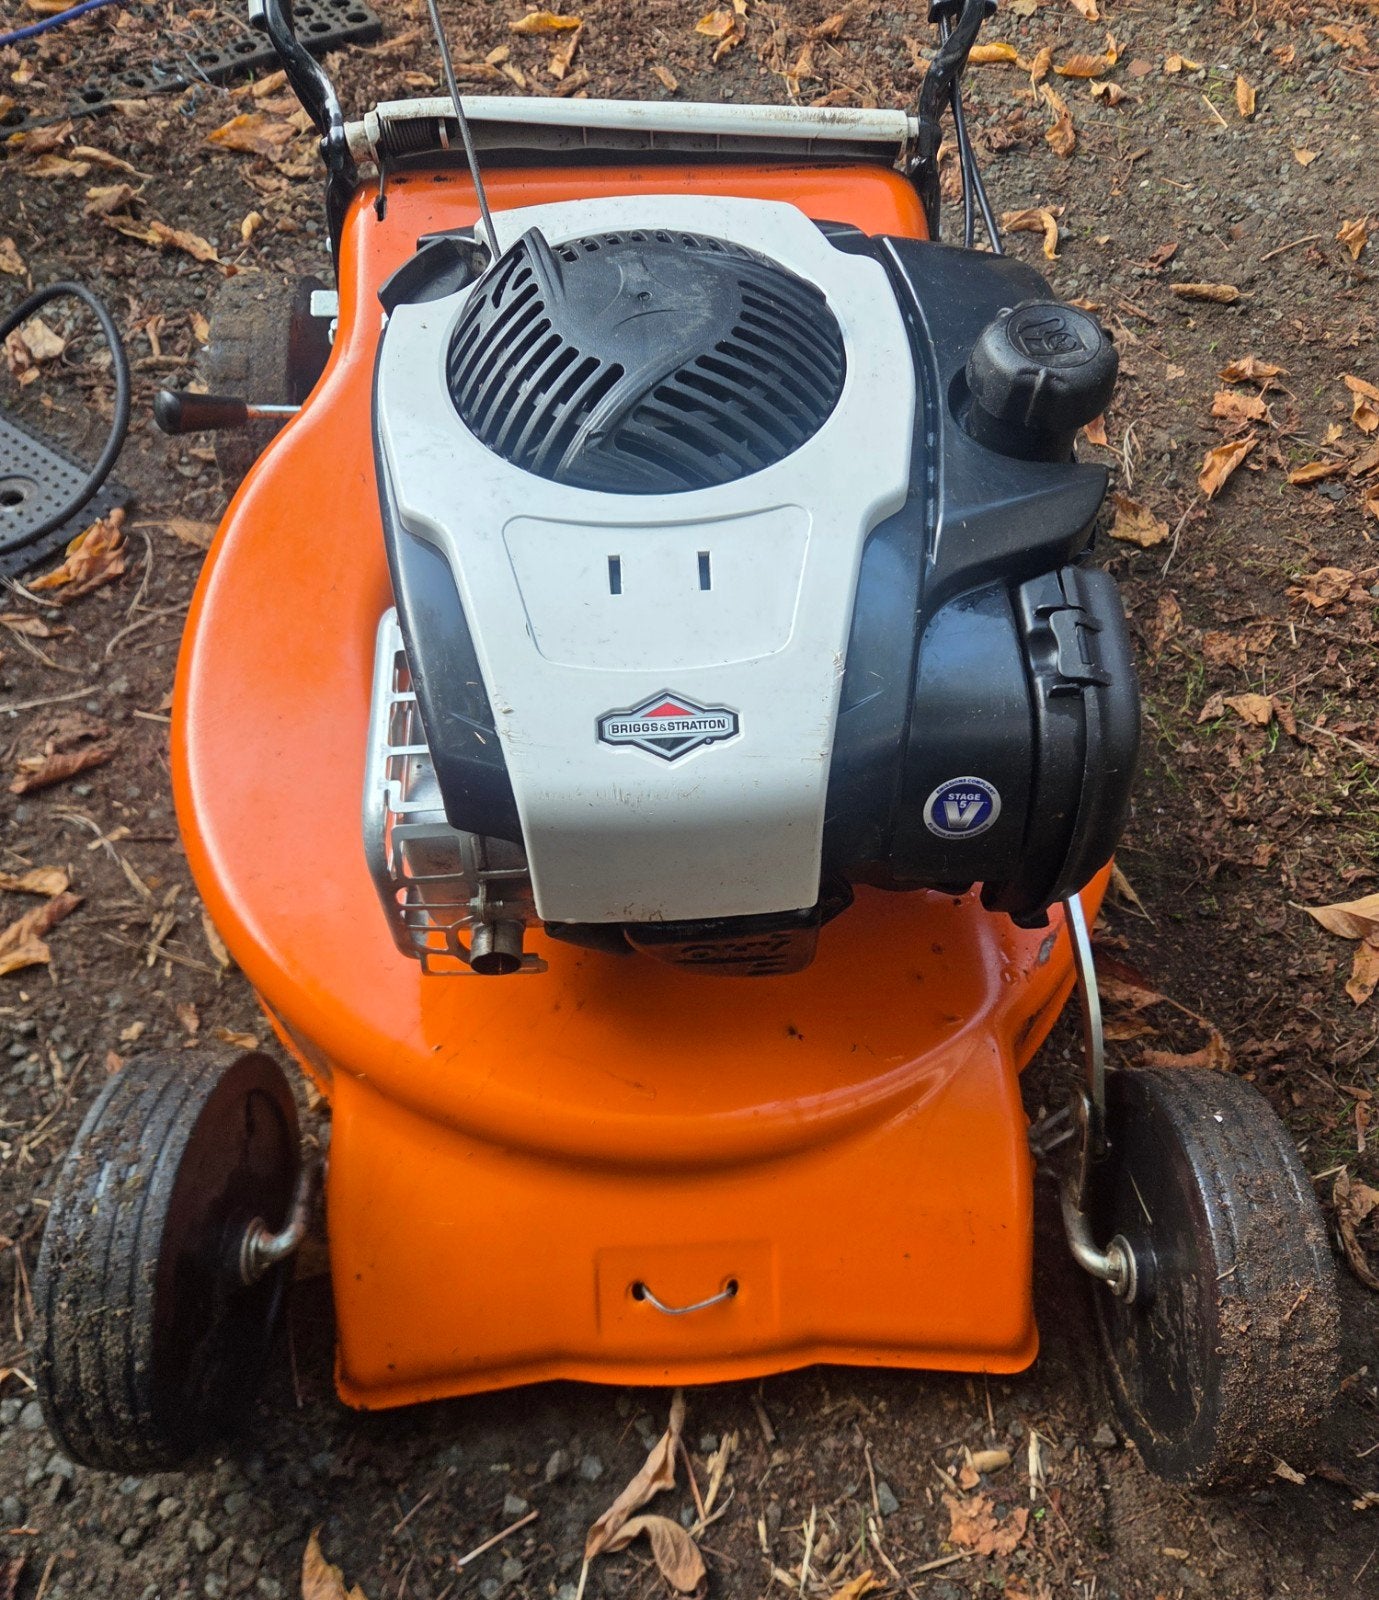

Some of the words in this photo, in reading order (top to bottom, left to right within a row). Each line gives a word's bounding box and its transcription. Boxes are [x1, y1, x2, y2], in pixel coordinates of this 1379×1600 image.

[611, 718, 726, 734] BRIGGS&STRATTON
[948, 793, 981, 801] STAGE
[959, 800, 967, 809] 5
[943, 801, 985, 828] V
